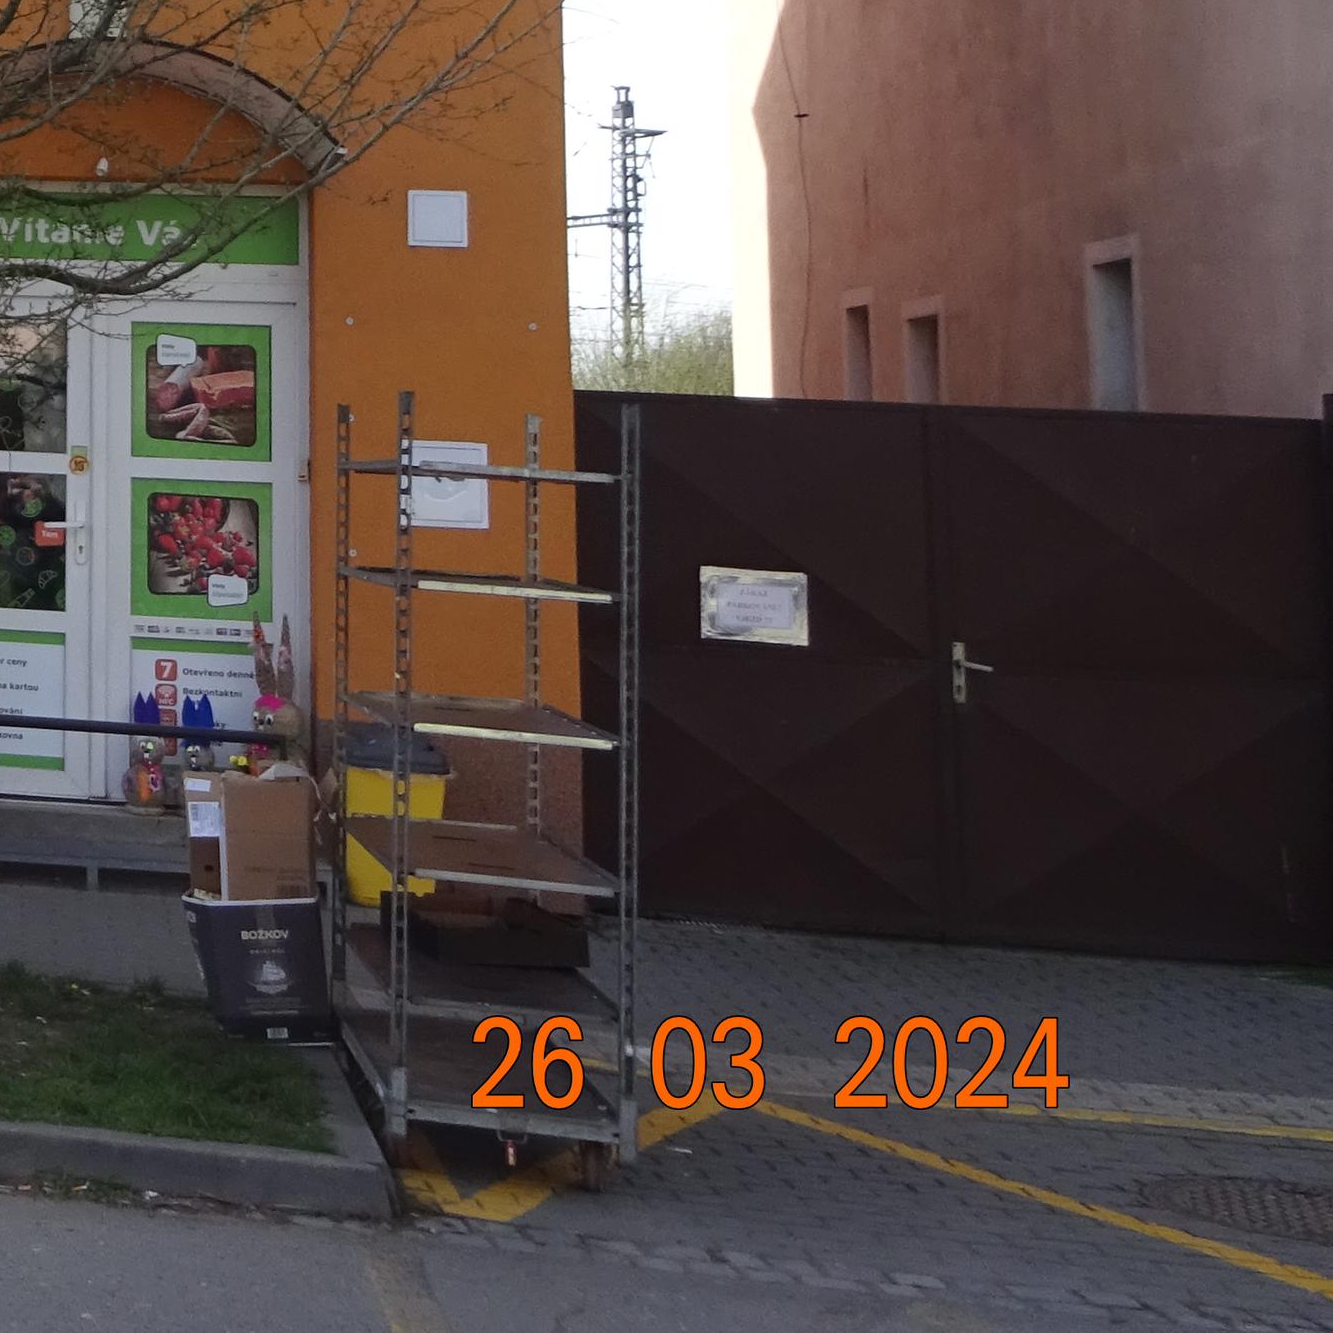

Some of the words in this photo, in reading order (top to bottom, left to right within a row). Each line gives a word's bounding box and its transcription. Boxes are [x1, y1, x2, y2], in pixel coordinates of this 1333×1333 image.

[7, 658, 27, 667] ceny
[160, 661, 173, 679] 7
[183, 668, 225, 677] Otevřeno
[9, 681, 39, 691] kartou
